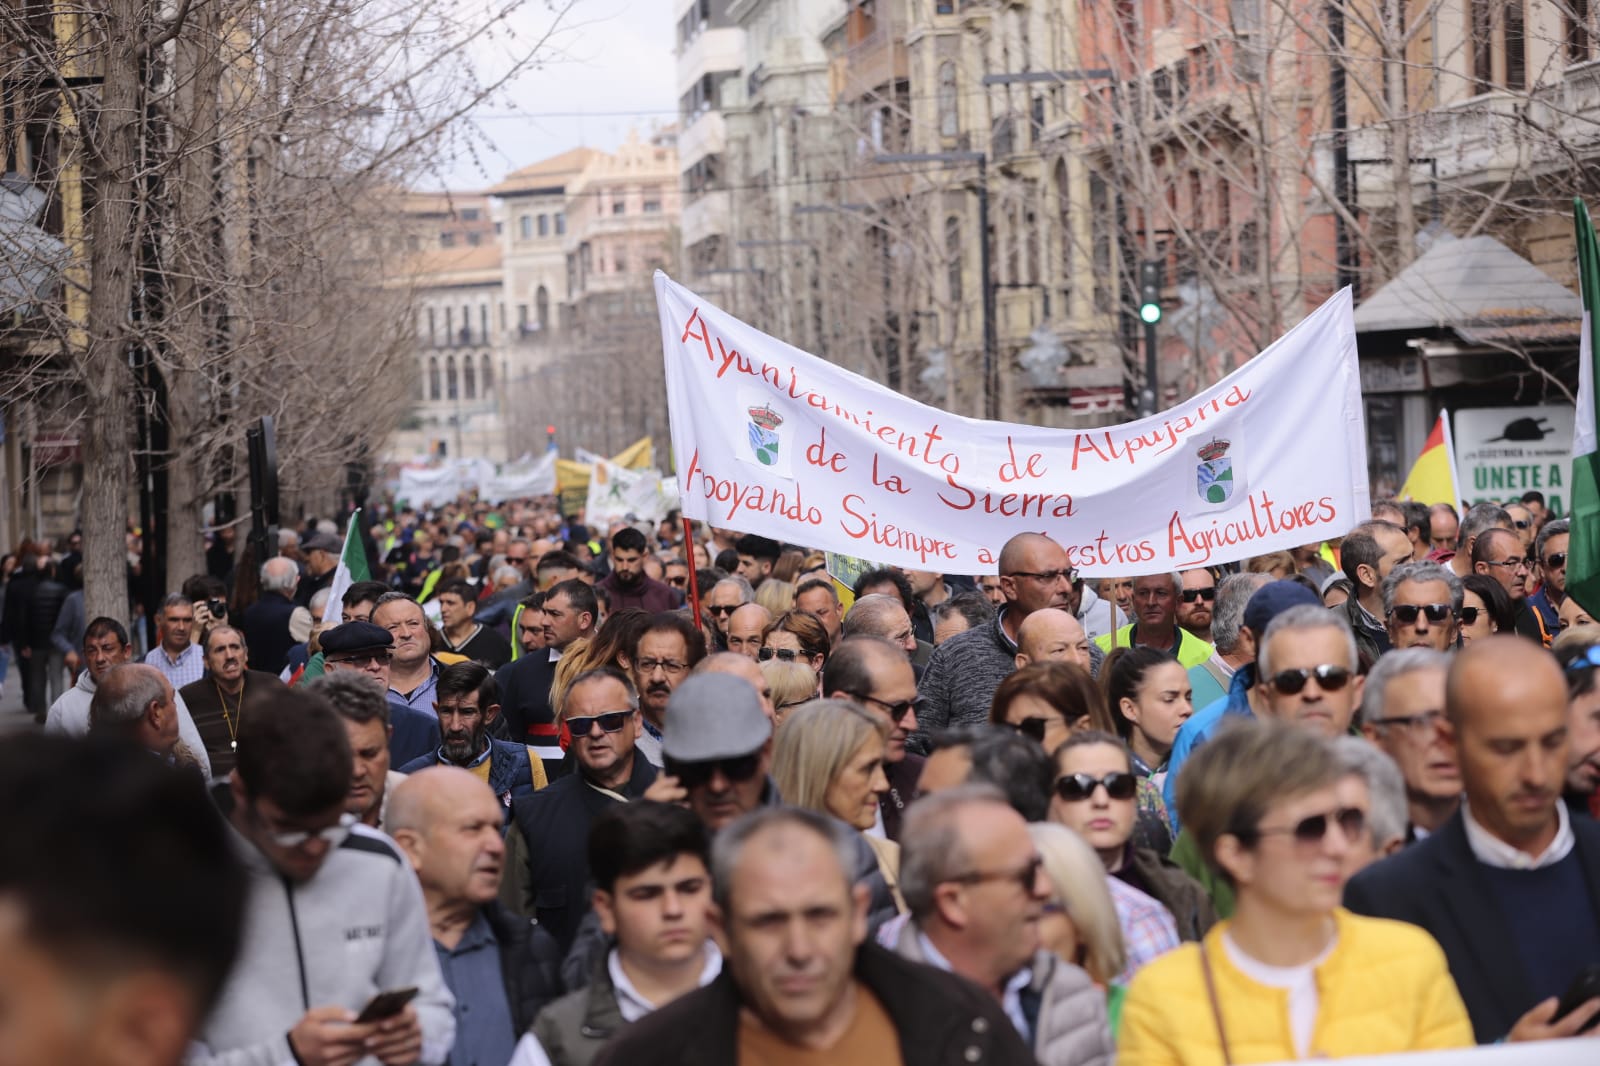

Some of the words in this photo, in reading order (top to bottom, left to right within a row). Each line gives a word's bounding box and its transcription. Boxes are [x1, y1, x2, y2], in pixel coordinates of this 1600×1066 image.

[682, 307, 960, 475] Ayuntamiento
[998, 435, 1047, 482] de
[1071, 384, 1251, 470] Alpujarra
[806, 426, 848, 473] de
[872, 451, 917, 495] la
[938, 475, 1078, 518] Sierra
[1548, 464, 1562, 487] A
[840, 493, 957, 563] Siempre
[1040, 529, 1156, 567] estros
[1167, 490, 1336, 567] Agricultores
